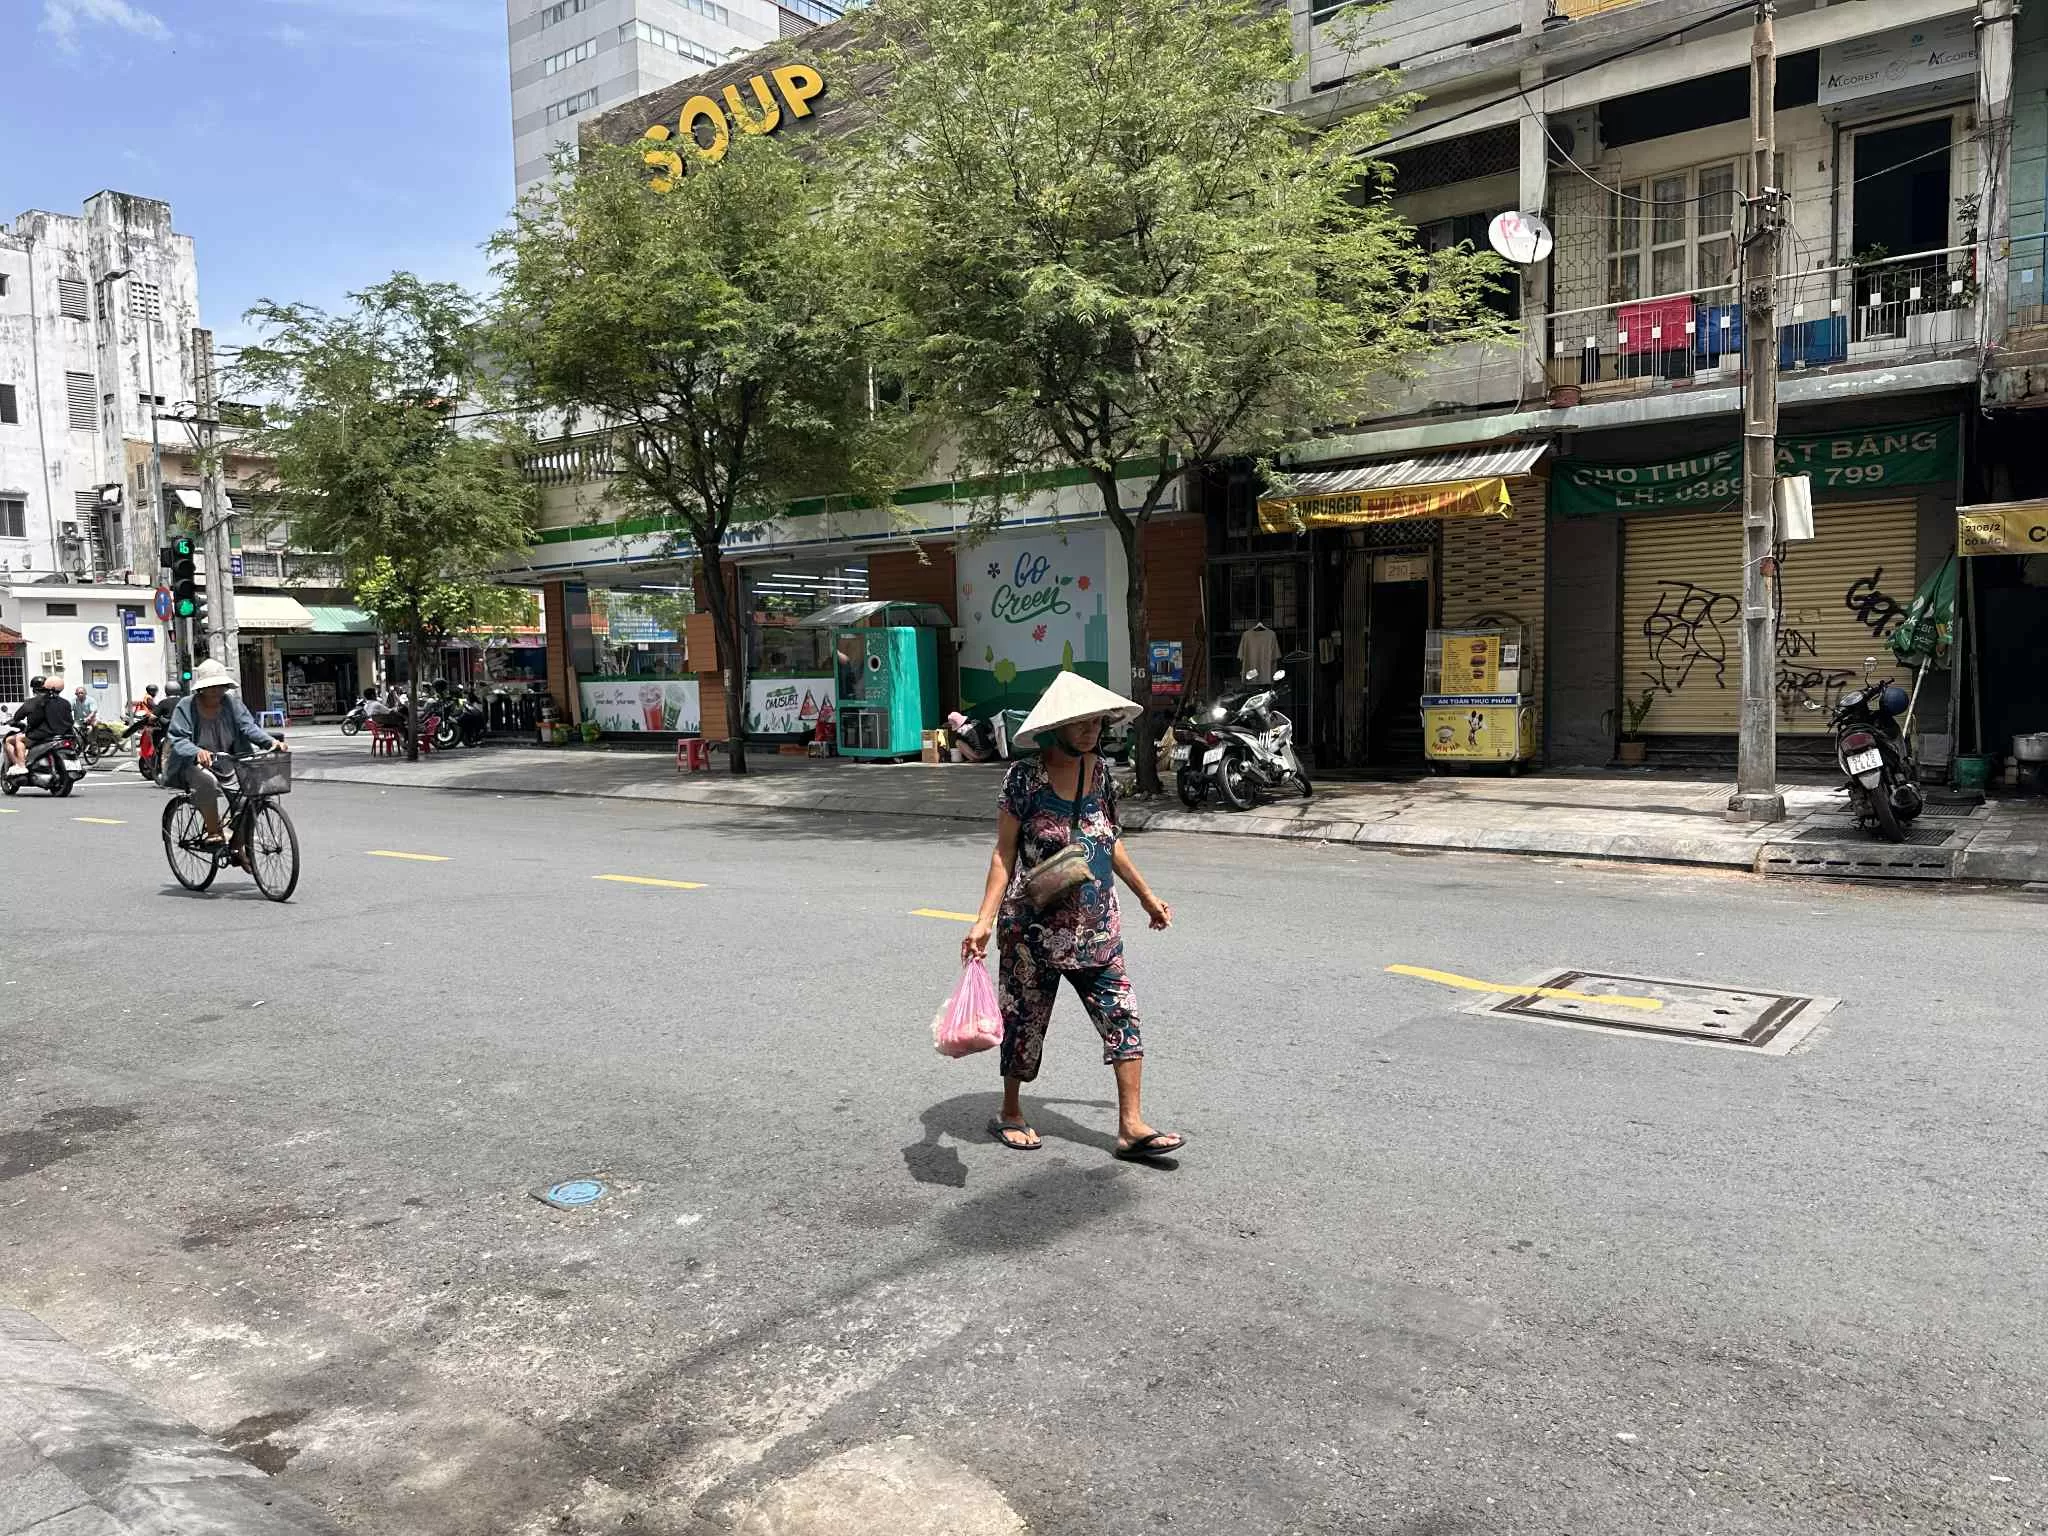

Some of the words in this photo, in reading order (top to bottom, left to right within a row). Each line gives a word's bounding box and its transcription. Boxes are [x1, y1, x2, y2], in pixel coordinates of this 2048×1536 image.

[1827, 71, 1880, 89] ALGOREST
[641, 63, 825, 195] SOUP
[1573, 467, 1638, 486] CHO
[1775, 441, 1819, 468] ẶT
[1616, 486, 1665, 507] LH:
[1824, 464, 1885, 486] 799
[1290, 495, 1361, 518] AMBURGER
[991, 584, 1071, 624] Green
